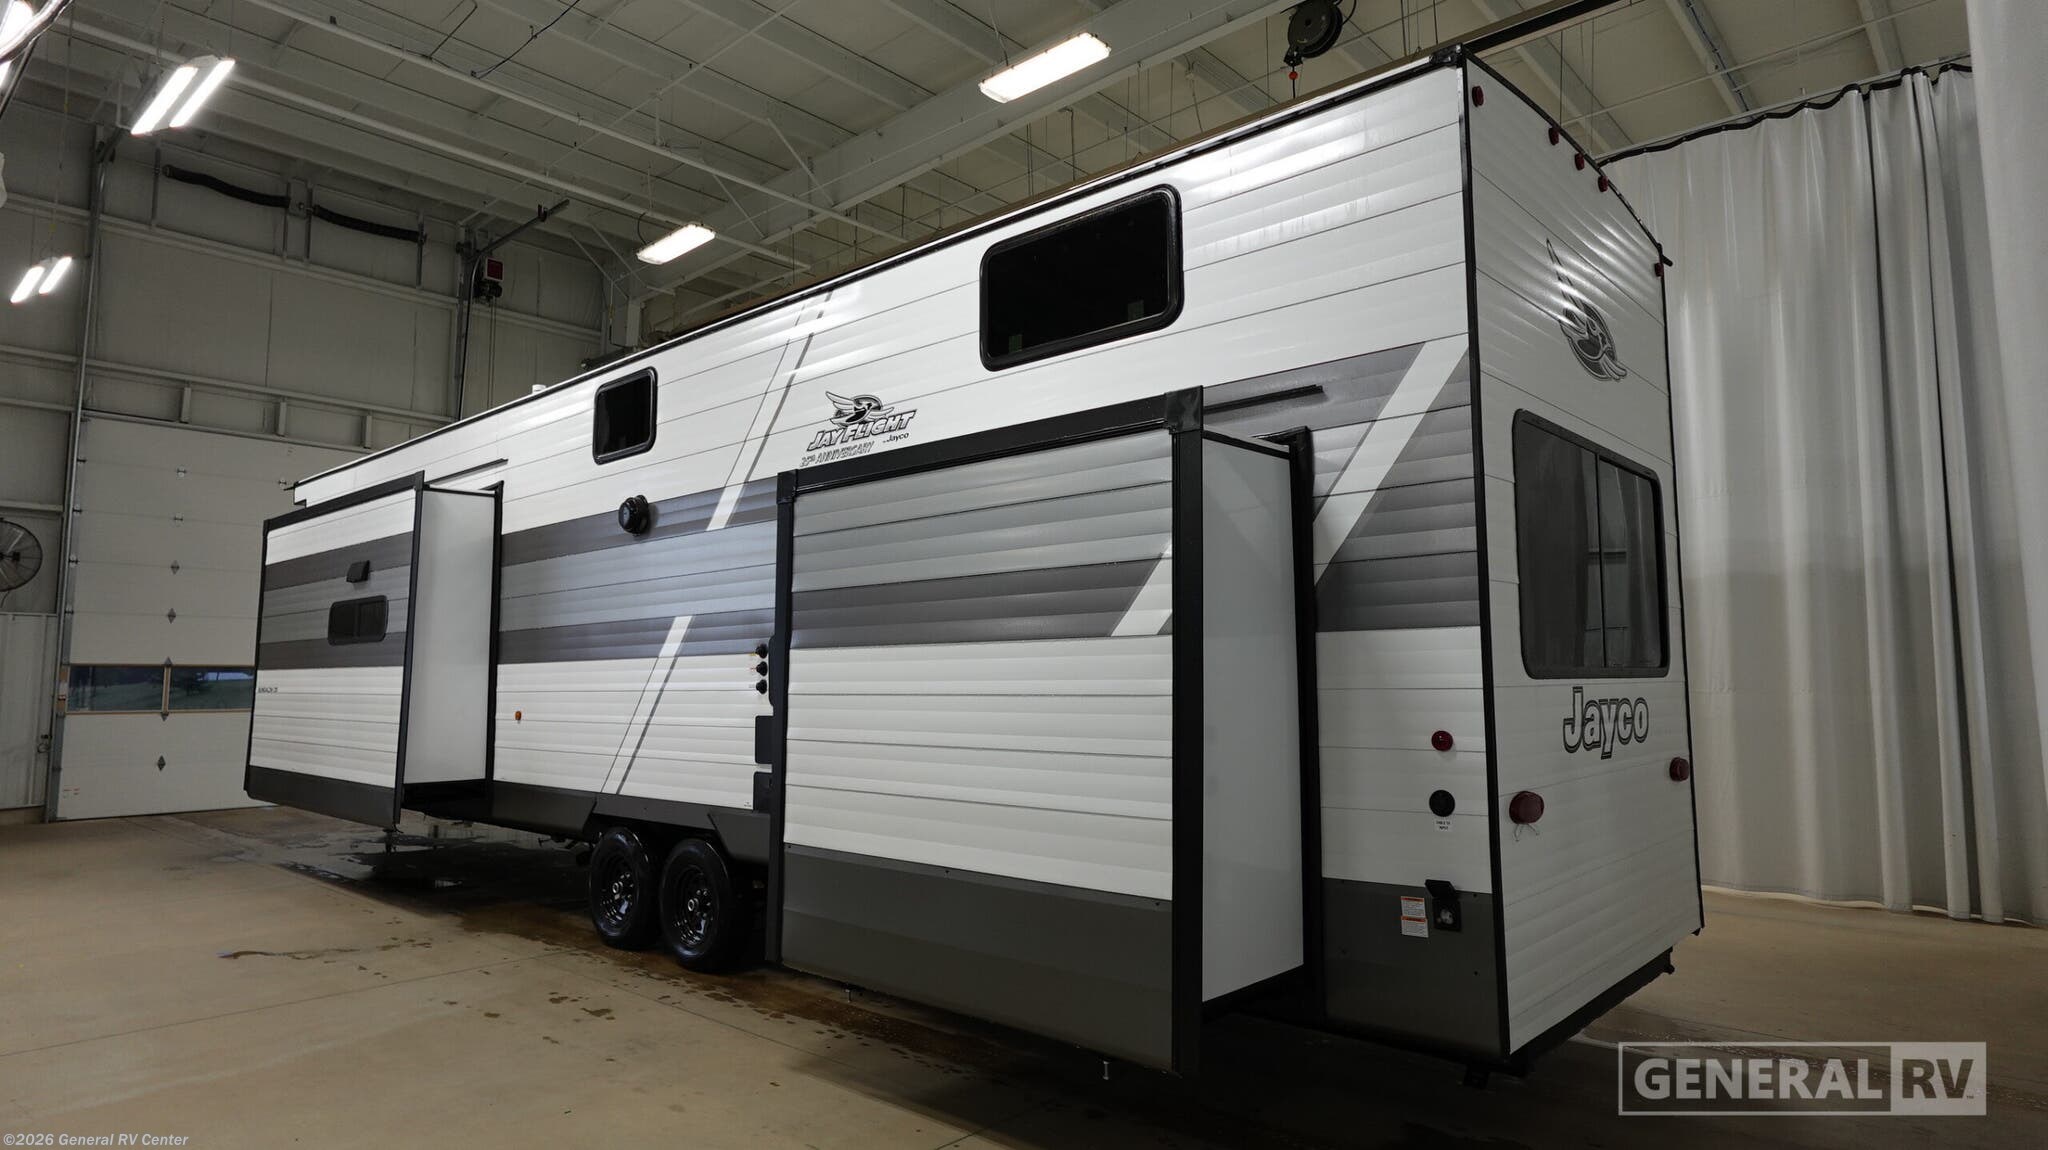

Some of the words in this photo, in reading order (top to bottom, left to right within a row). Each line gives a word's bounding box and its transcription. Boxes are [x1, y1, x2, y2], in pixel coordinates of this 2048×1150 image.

[806, 427, 845, 452] JAY
[840, 409, 918, 444] FLIGHT
[1562, 686, 1649, 760] Jayco
